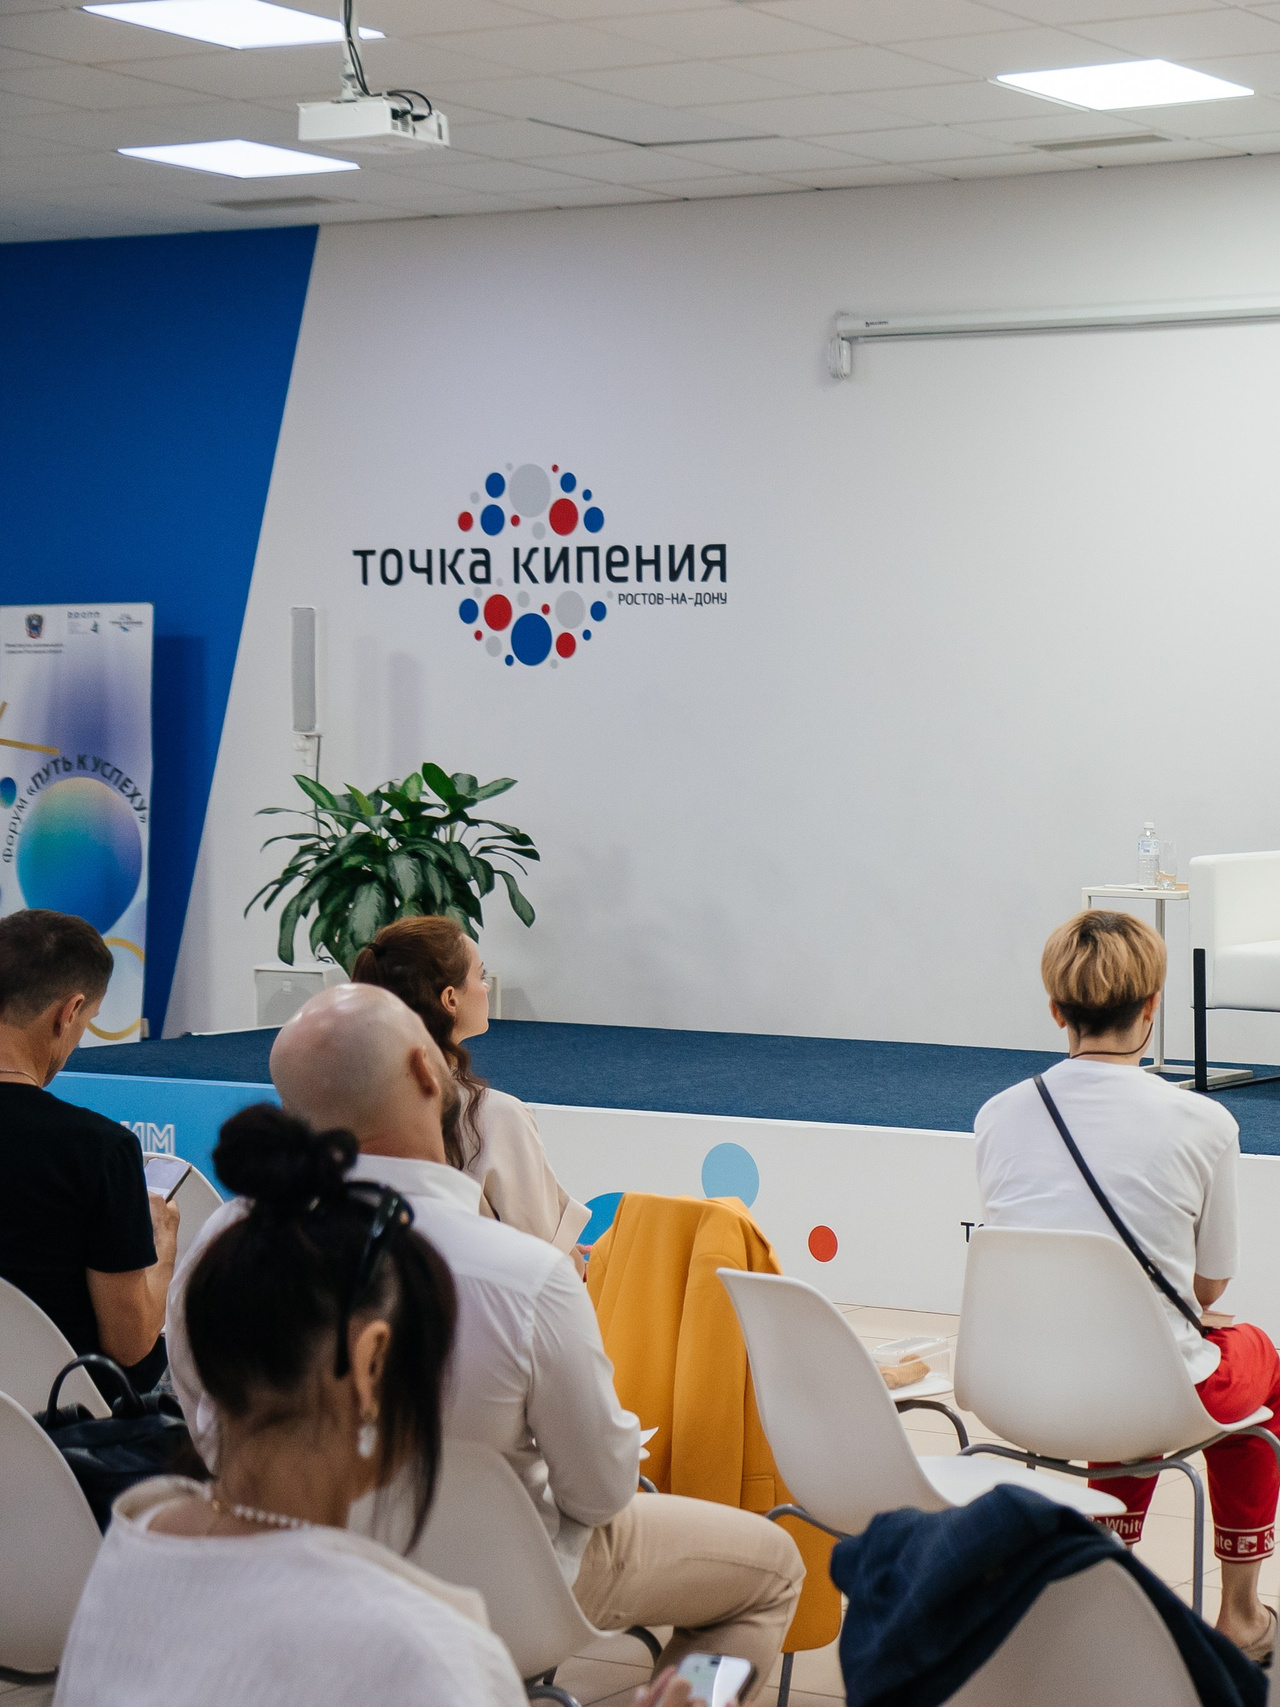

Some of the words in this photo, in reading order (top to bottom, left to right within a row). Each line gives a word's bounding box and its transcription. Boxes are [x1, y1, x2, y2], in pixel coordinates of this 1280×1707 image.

[617, 592, 728, 608] РОСТОВ-НА-ДОНУ
[76, 754, 88, 771] К
[1105, 1517, 1142, 1534] Whit
[1215, 1532, 1233, 1551] ite
